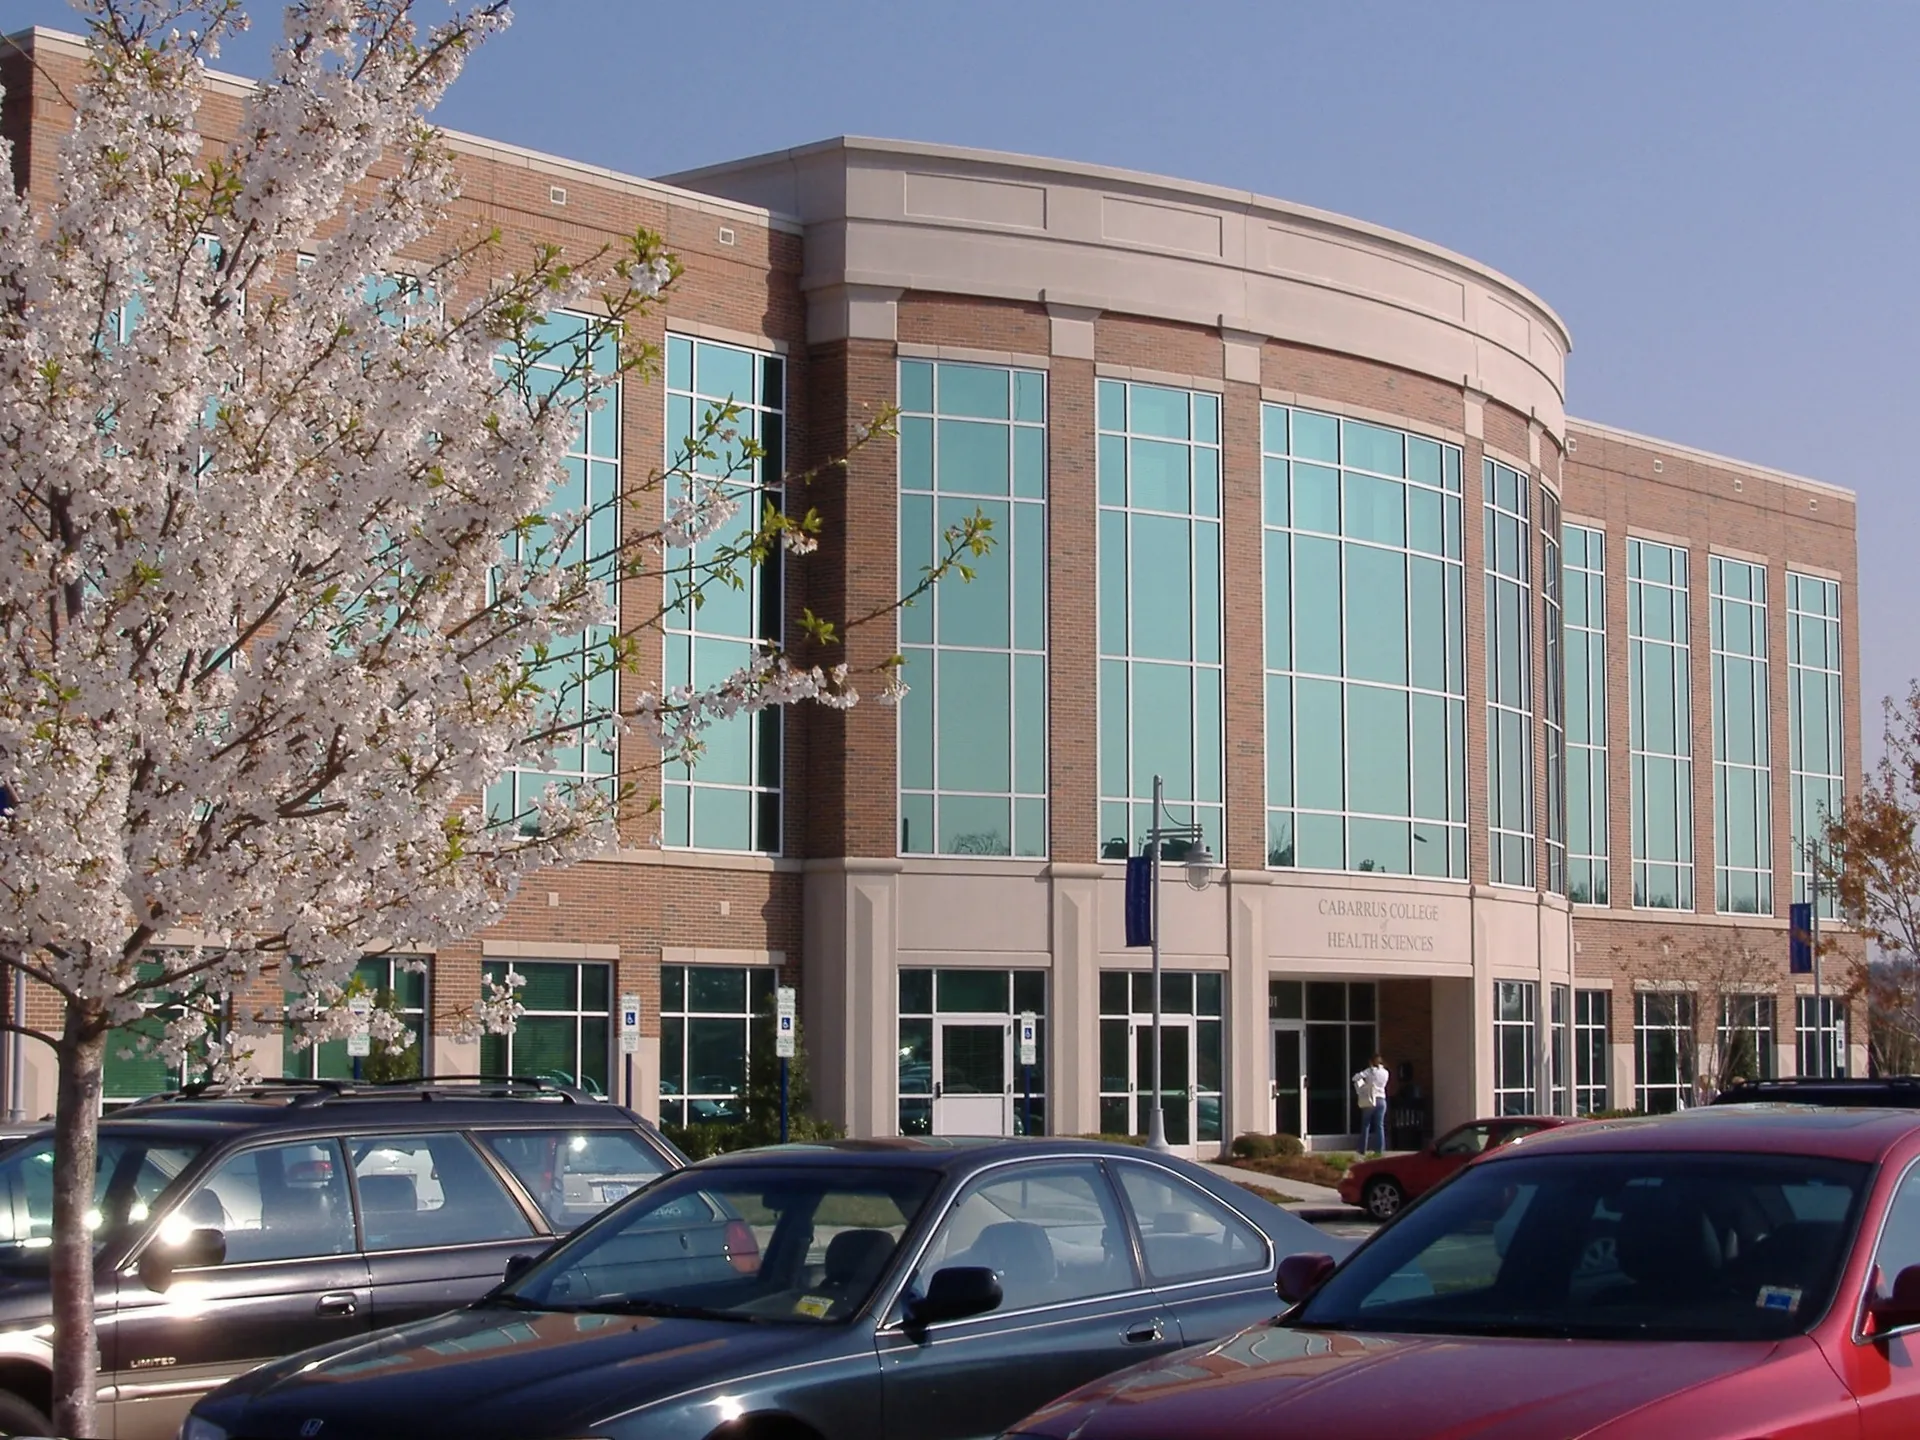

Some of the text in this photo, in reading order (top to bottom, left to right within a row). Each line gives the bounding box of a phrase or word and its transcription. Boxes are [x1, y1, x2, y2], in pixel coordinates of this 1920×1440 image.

[1318, 899, 1440, 921] CABARRUS COLLEGE
[1327, 931, 1434, 952] HEALTH SCIENCES
[130, 1356, 176, 1369] LIMITED
